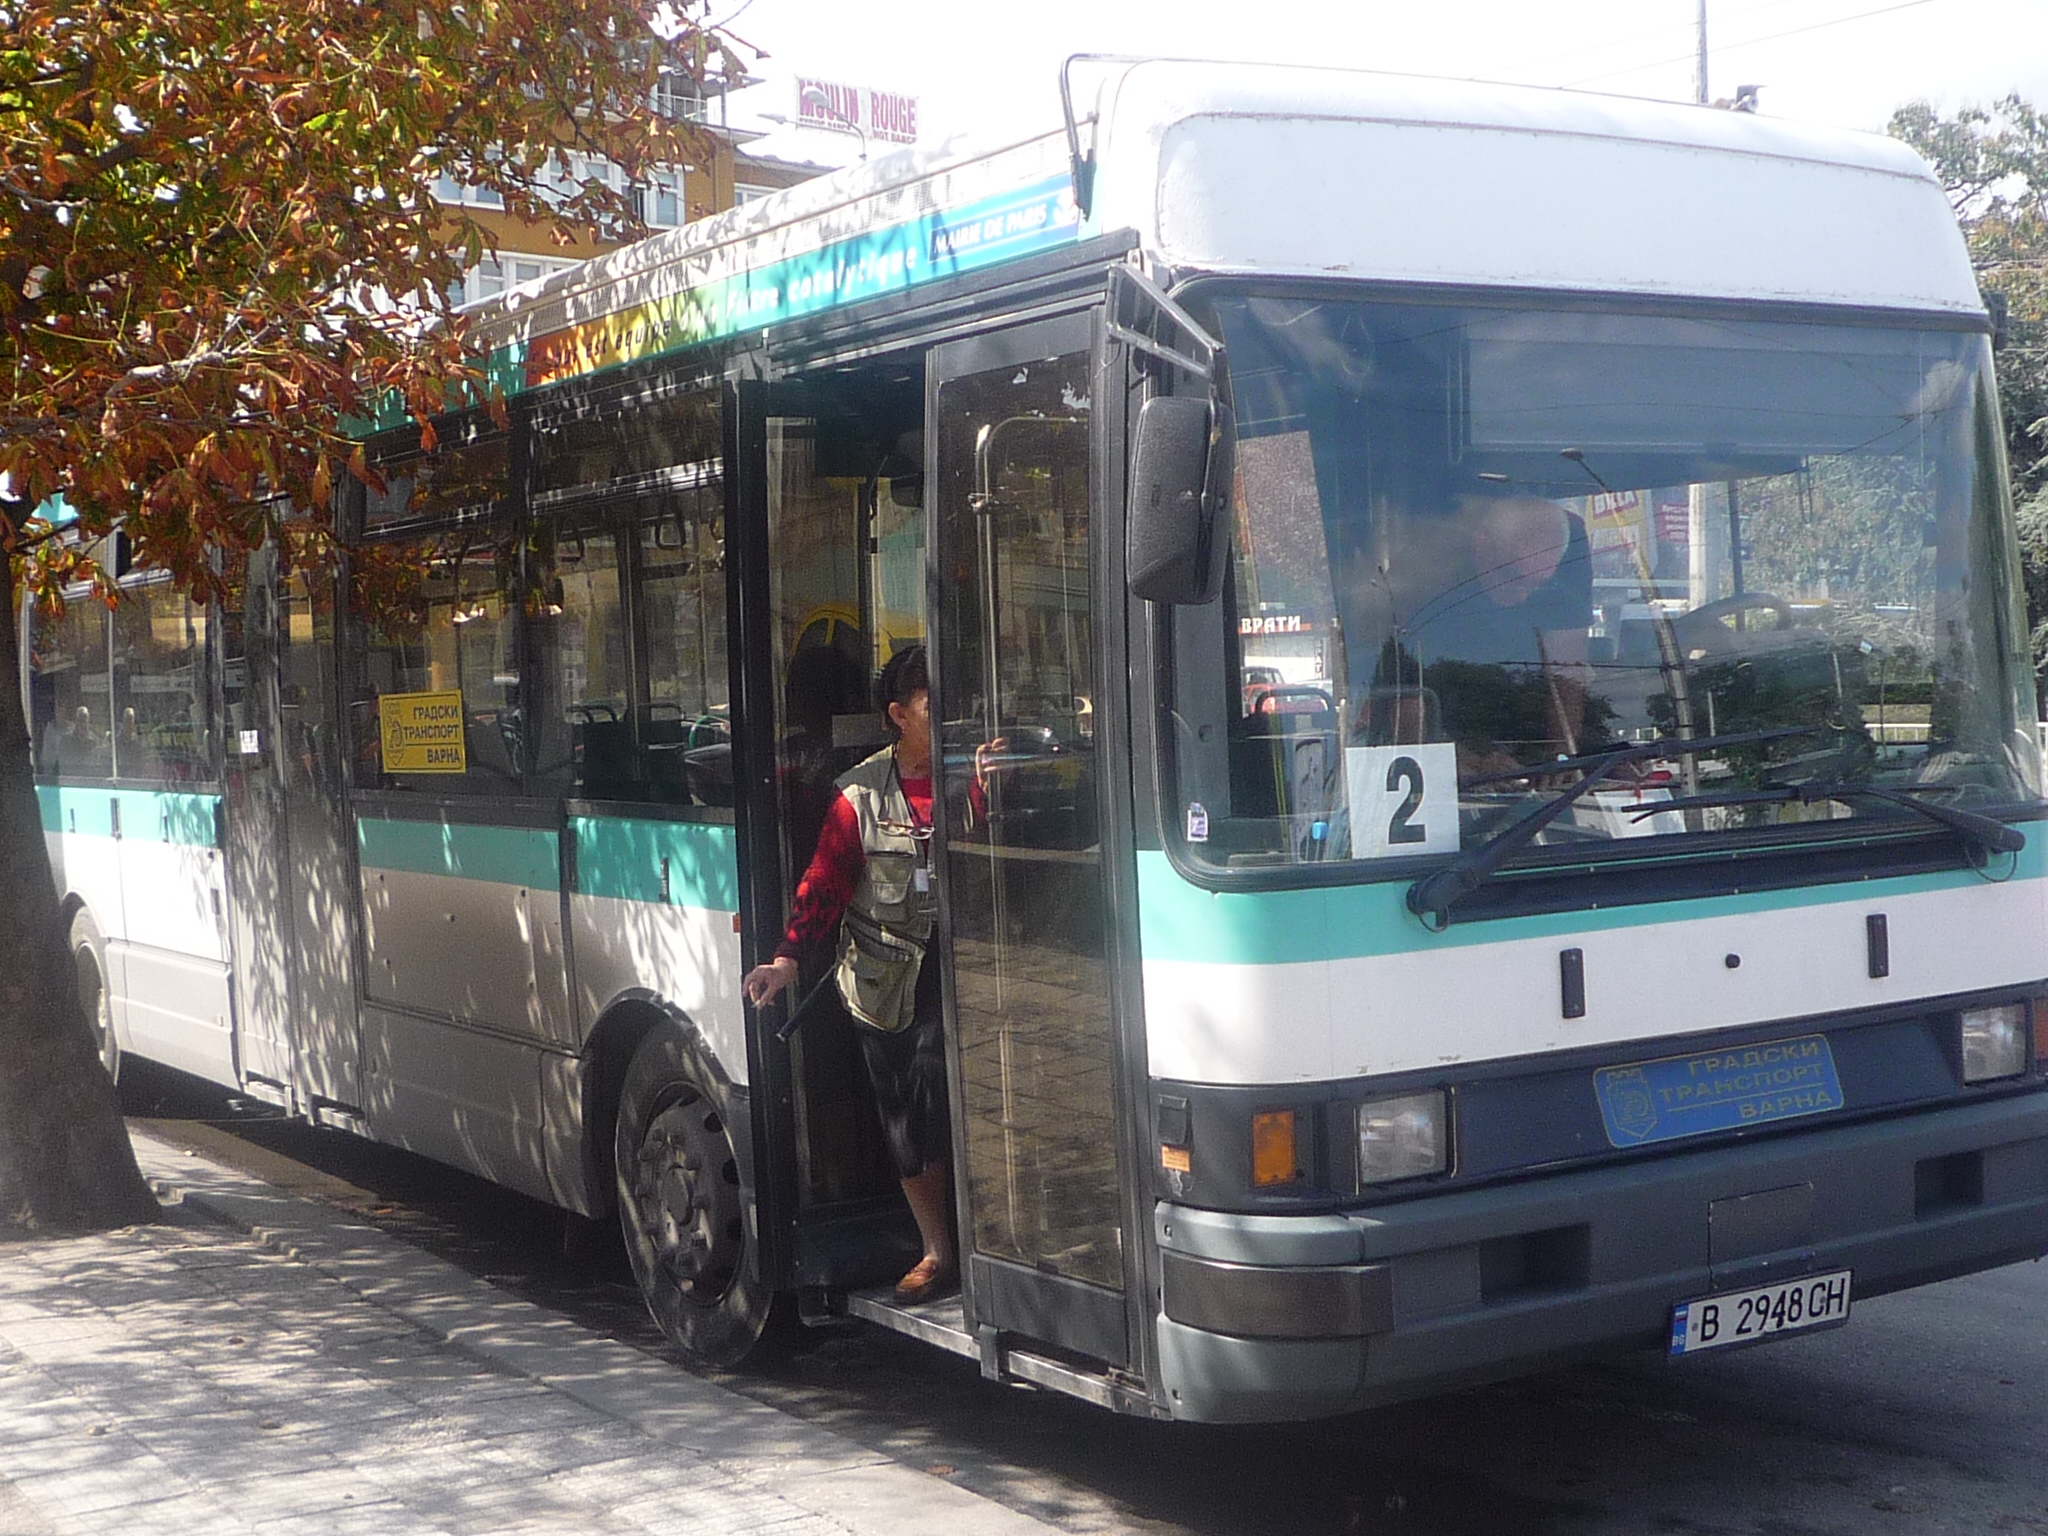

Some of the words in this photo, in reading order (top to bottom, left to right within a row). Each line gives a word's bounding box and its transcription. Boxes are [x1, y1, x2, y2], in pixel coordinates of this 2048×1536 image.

[799, 79, 859, 124] MOULIN
[870, 91, 917, 135] ROUGE
[933, 222, 982, 253] MAIRIE
[983, 215, 1004, 240] DE
[1006, 203, 1048, 234] PARIS
[586, 335, 608, 359] est
[787, 248, 917, 301] catalytique
[1594, 491, 1636, 514] BILLA
[1241, 615, 1301, 634] ВРАТИ
[413, 705, 458, 722] ГРАДСКИ
[404, 724, 459, 740] ТРАНСПОРТ
[427, 748, 460, 763] ВАРНА
[1386, 756, 1426, 845] 2
[1687, 1041, 1819, 1076] ГРАДСКИ
[1658, 1063, 1823, 1104] ТРАНСПОРТ
[1739, 1090, 1833, 1119] ВАРНА
[1700, 1304, 1720, 1342] B
[1735, 1287, 1803, 1335] 2948
[1808, 1278, 1846, 1317] CH
[1672, 1334, 1685, 1347] BG
